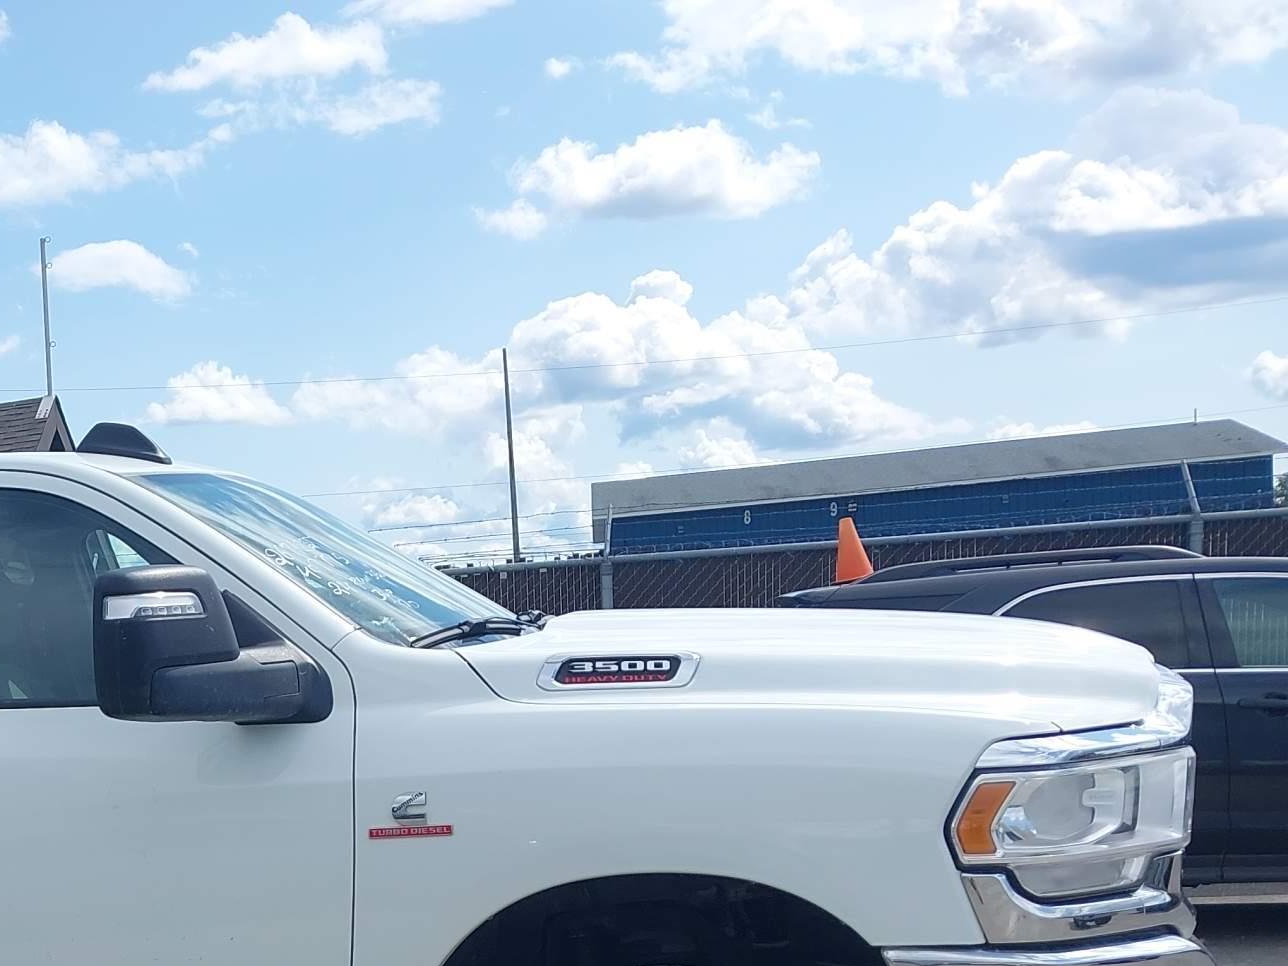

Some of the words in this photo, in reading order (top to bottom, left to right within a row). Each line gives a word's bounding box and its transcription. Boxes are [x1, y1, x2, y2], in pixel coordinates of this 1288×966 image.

[830, 501, 838, 517] 9
[743, 509, 752, 525] 8
[568, 659, 671, 672] 3500
[564, 674, 619, 683] HEAVY
[621, 674, 667, 682] DUTY
[392, 791, 424, 813] Cummins
[371, 828, 409, 837] TURBO
[410, 826, 451, 835] DIESEL
